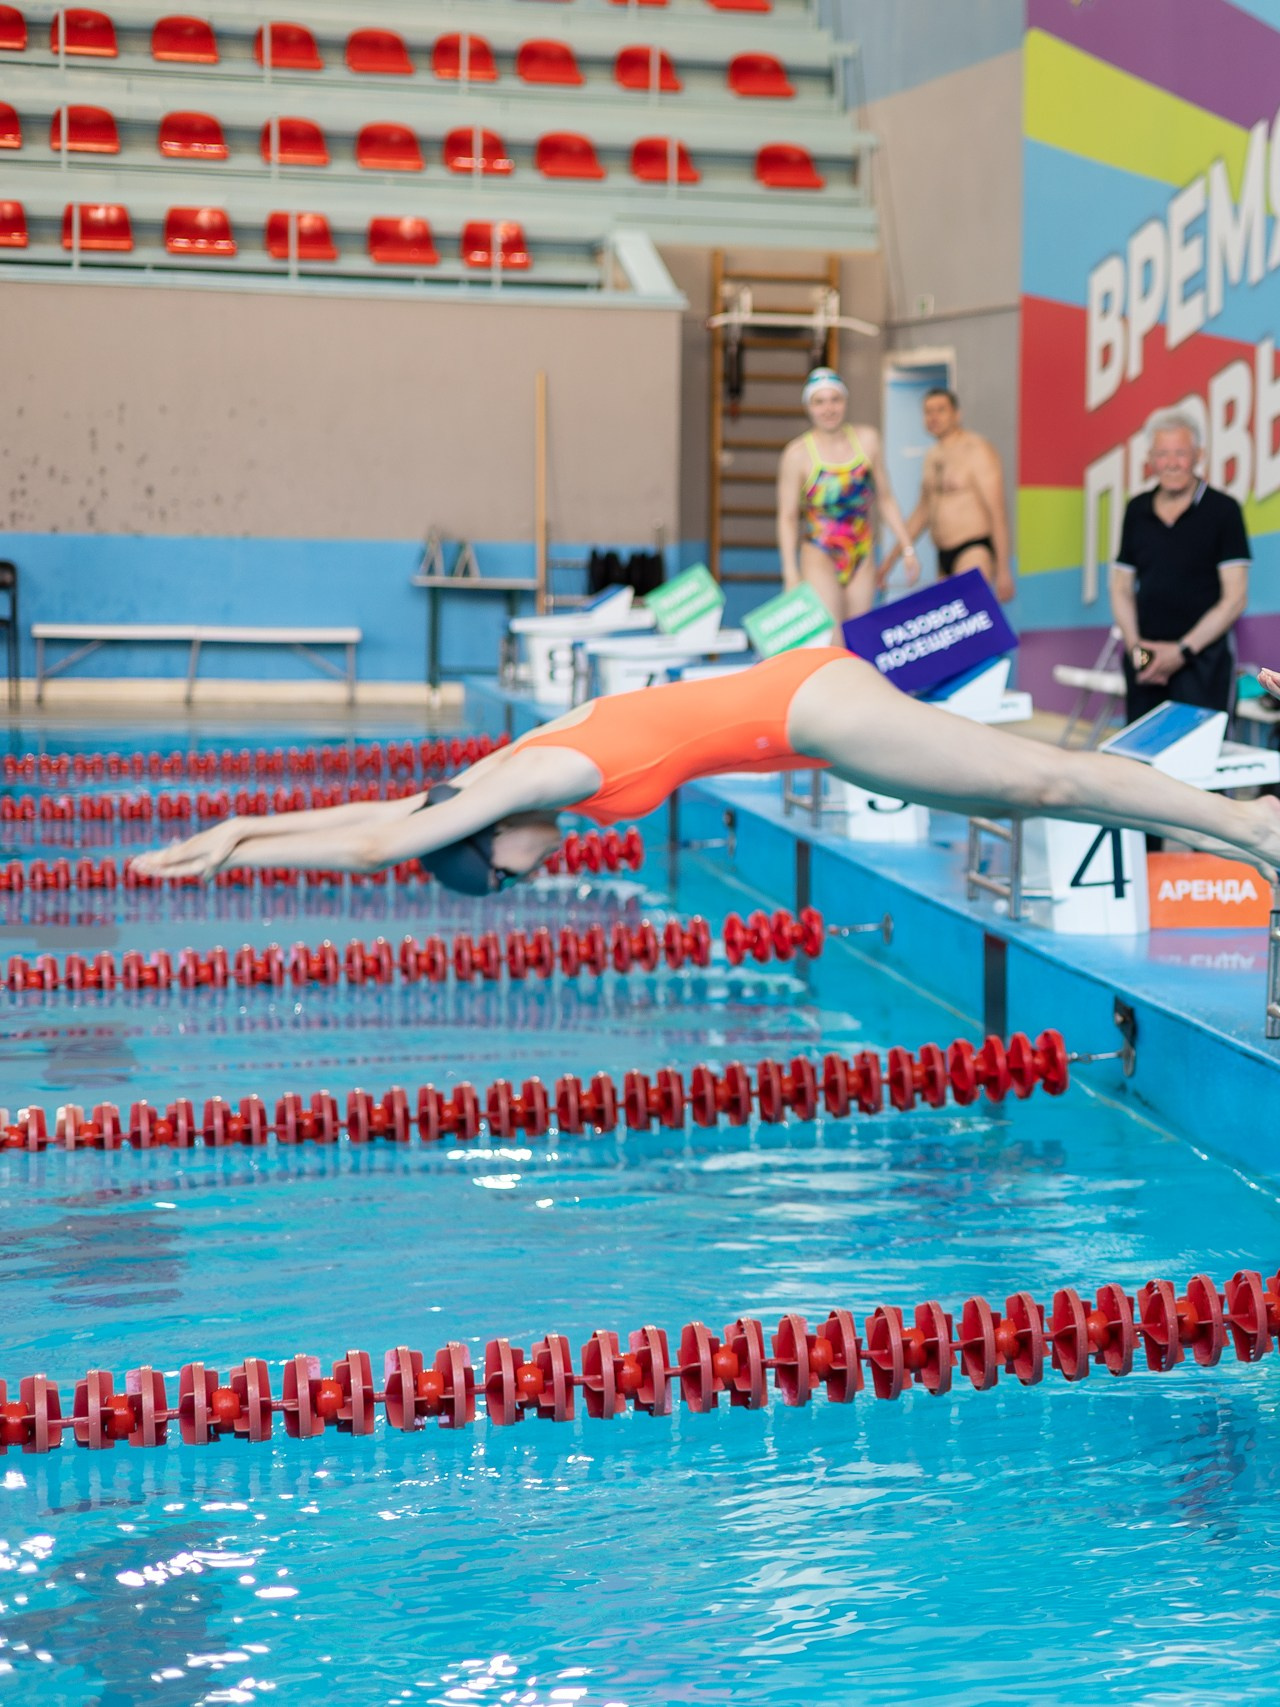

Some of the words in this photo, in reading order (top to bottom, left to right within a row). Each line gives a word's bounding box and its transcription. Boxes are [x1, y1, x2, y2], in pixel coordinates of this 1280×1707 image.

[875, 610, 993, 673] ПОСЕЩЕНИЕ
[881, 598, 969, 649] РАЗОВОЕ
[1071, 826, 1132, 899] 4
[1158, 879, 1258, 905] АРЕНДА
